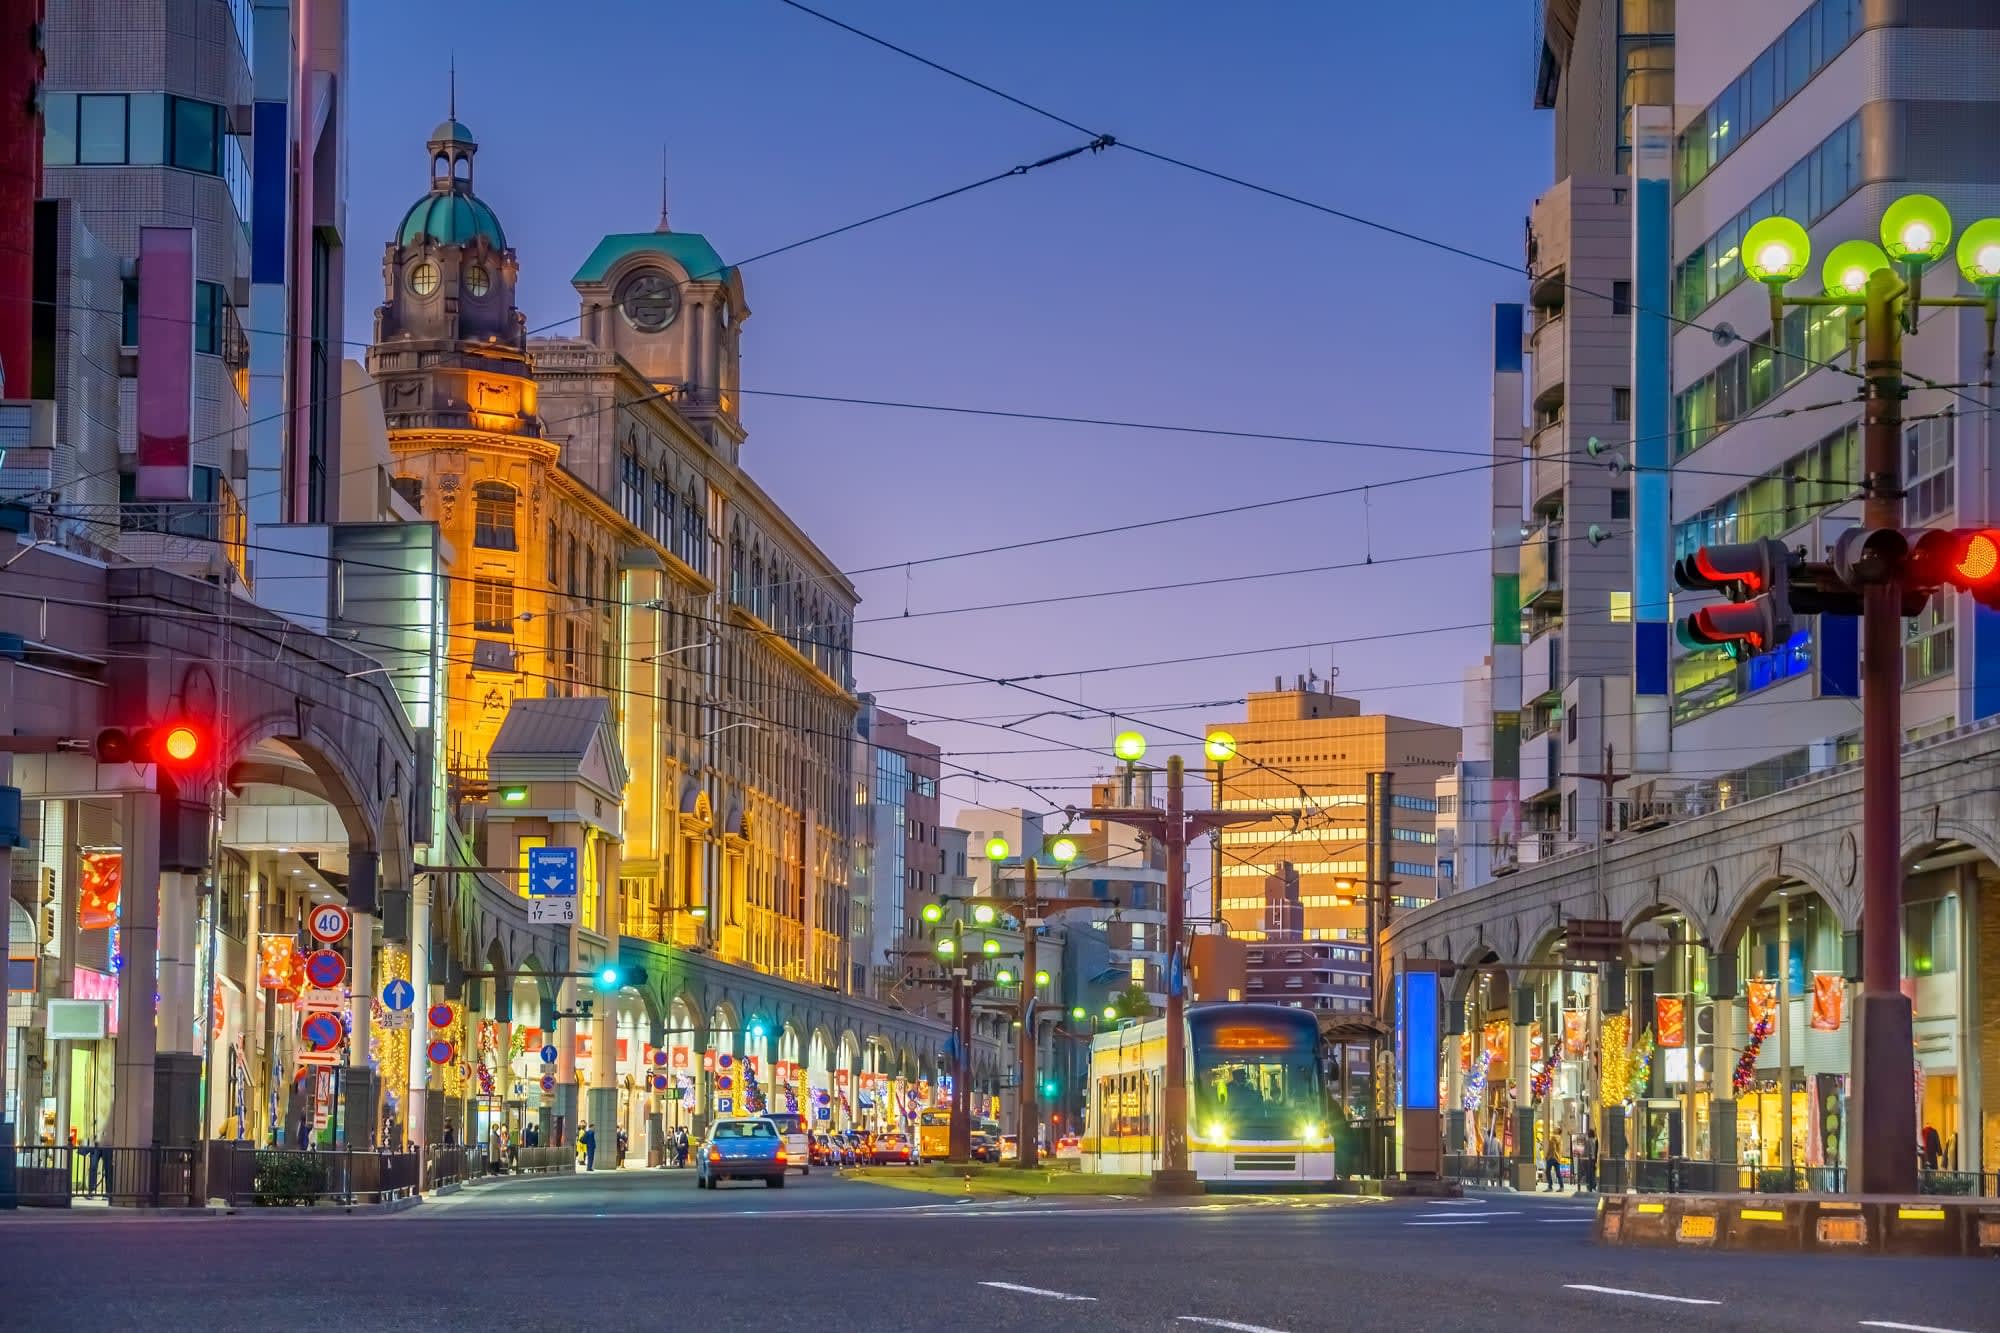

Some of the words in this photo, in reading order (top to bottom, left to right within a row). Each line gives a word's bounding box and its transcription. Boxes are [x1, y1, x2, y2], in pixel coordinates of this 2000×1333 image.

[534, 901, 541, 910] 7
[564, 901, 571, 910] 9
[532, 911, 543, 920] 17
[563, 911, 573, 920] 19
[318, 914, 340, 932] 40
[721, 1099, 730, 1112] P
[820, 1109, 828, 1119] P
